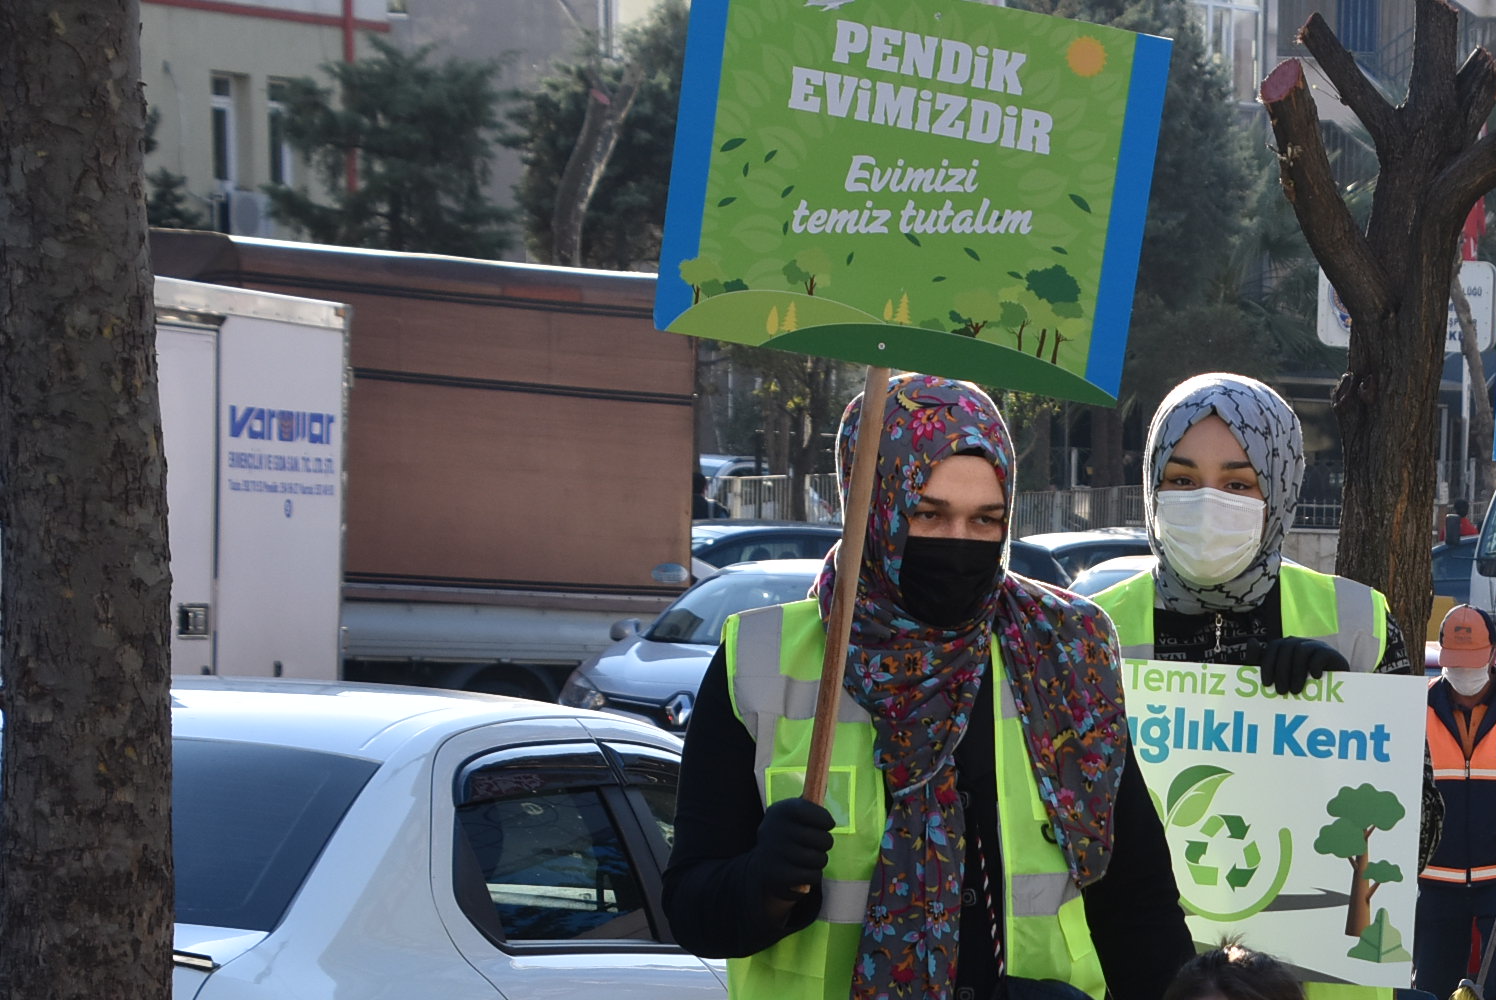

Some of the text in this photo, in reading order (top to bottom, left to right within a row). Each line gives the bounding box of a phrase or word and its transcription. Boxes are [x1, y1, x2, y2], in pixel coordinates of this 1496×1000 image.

[844, 155, 980, 194] Evimizi
[792, 198, 1033, 235] temiz tutalım
[1125, 659, 1344, 703] Temiz Soak
[1128, 703, 1391, 764] ğlıklı Kent
